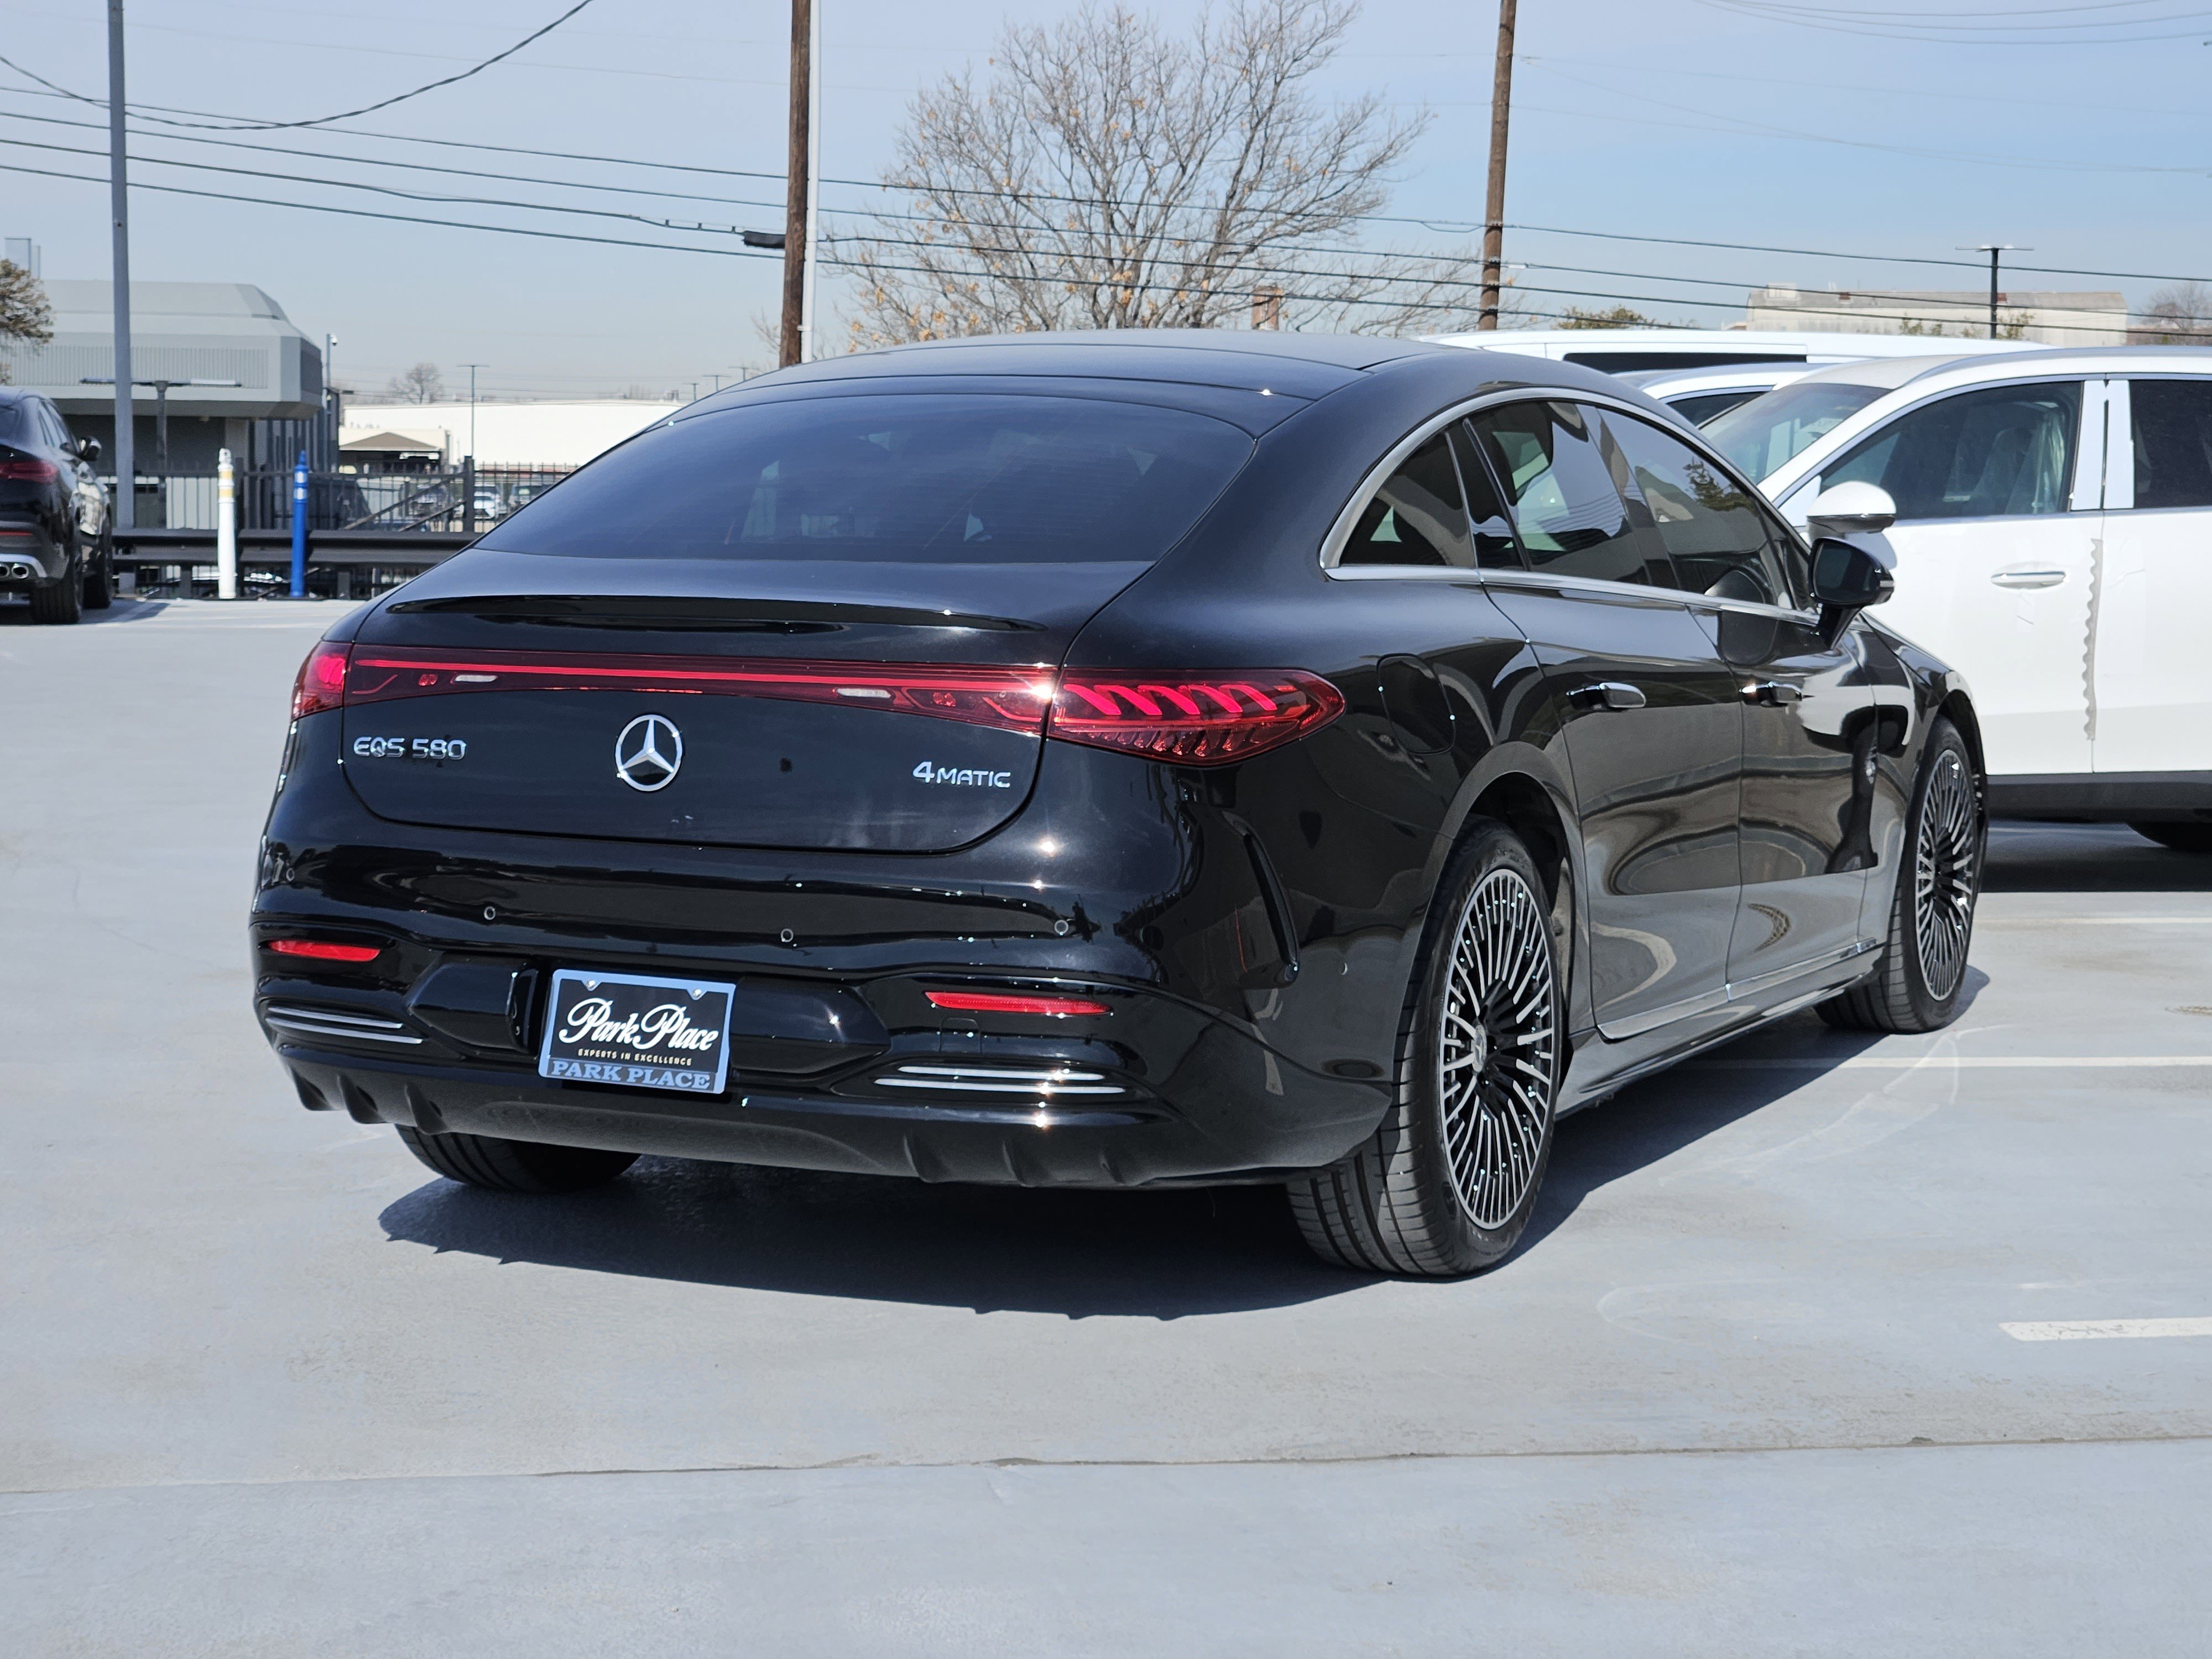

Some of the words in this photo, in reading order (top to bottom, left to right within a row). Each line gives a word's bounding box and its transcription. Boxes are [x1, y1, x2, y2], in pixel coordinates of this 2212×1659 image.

[353, 737, 405, 758] EQS
[412, 738, 467, 760] 580
[912, 761, 1011, 788] 4MATIC
[559, 998, 639, 1044] Park
[632, 1004, 718, 1051] Place
[578, 1048, 617, 1058] EXPERTS
[635, 1053, 692, 1066] EXCELLENCE
[552, 1061, 622, 1082] PARK
[625, 1068, 710, 1089] PLACE
